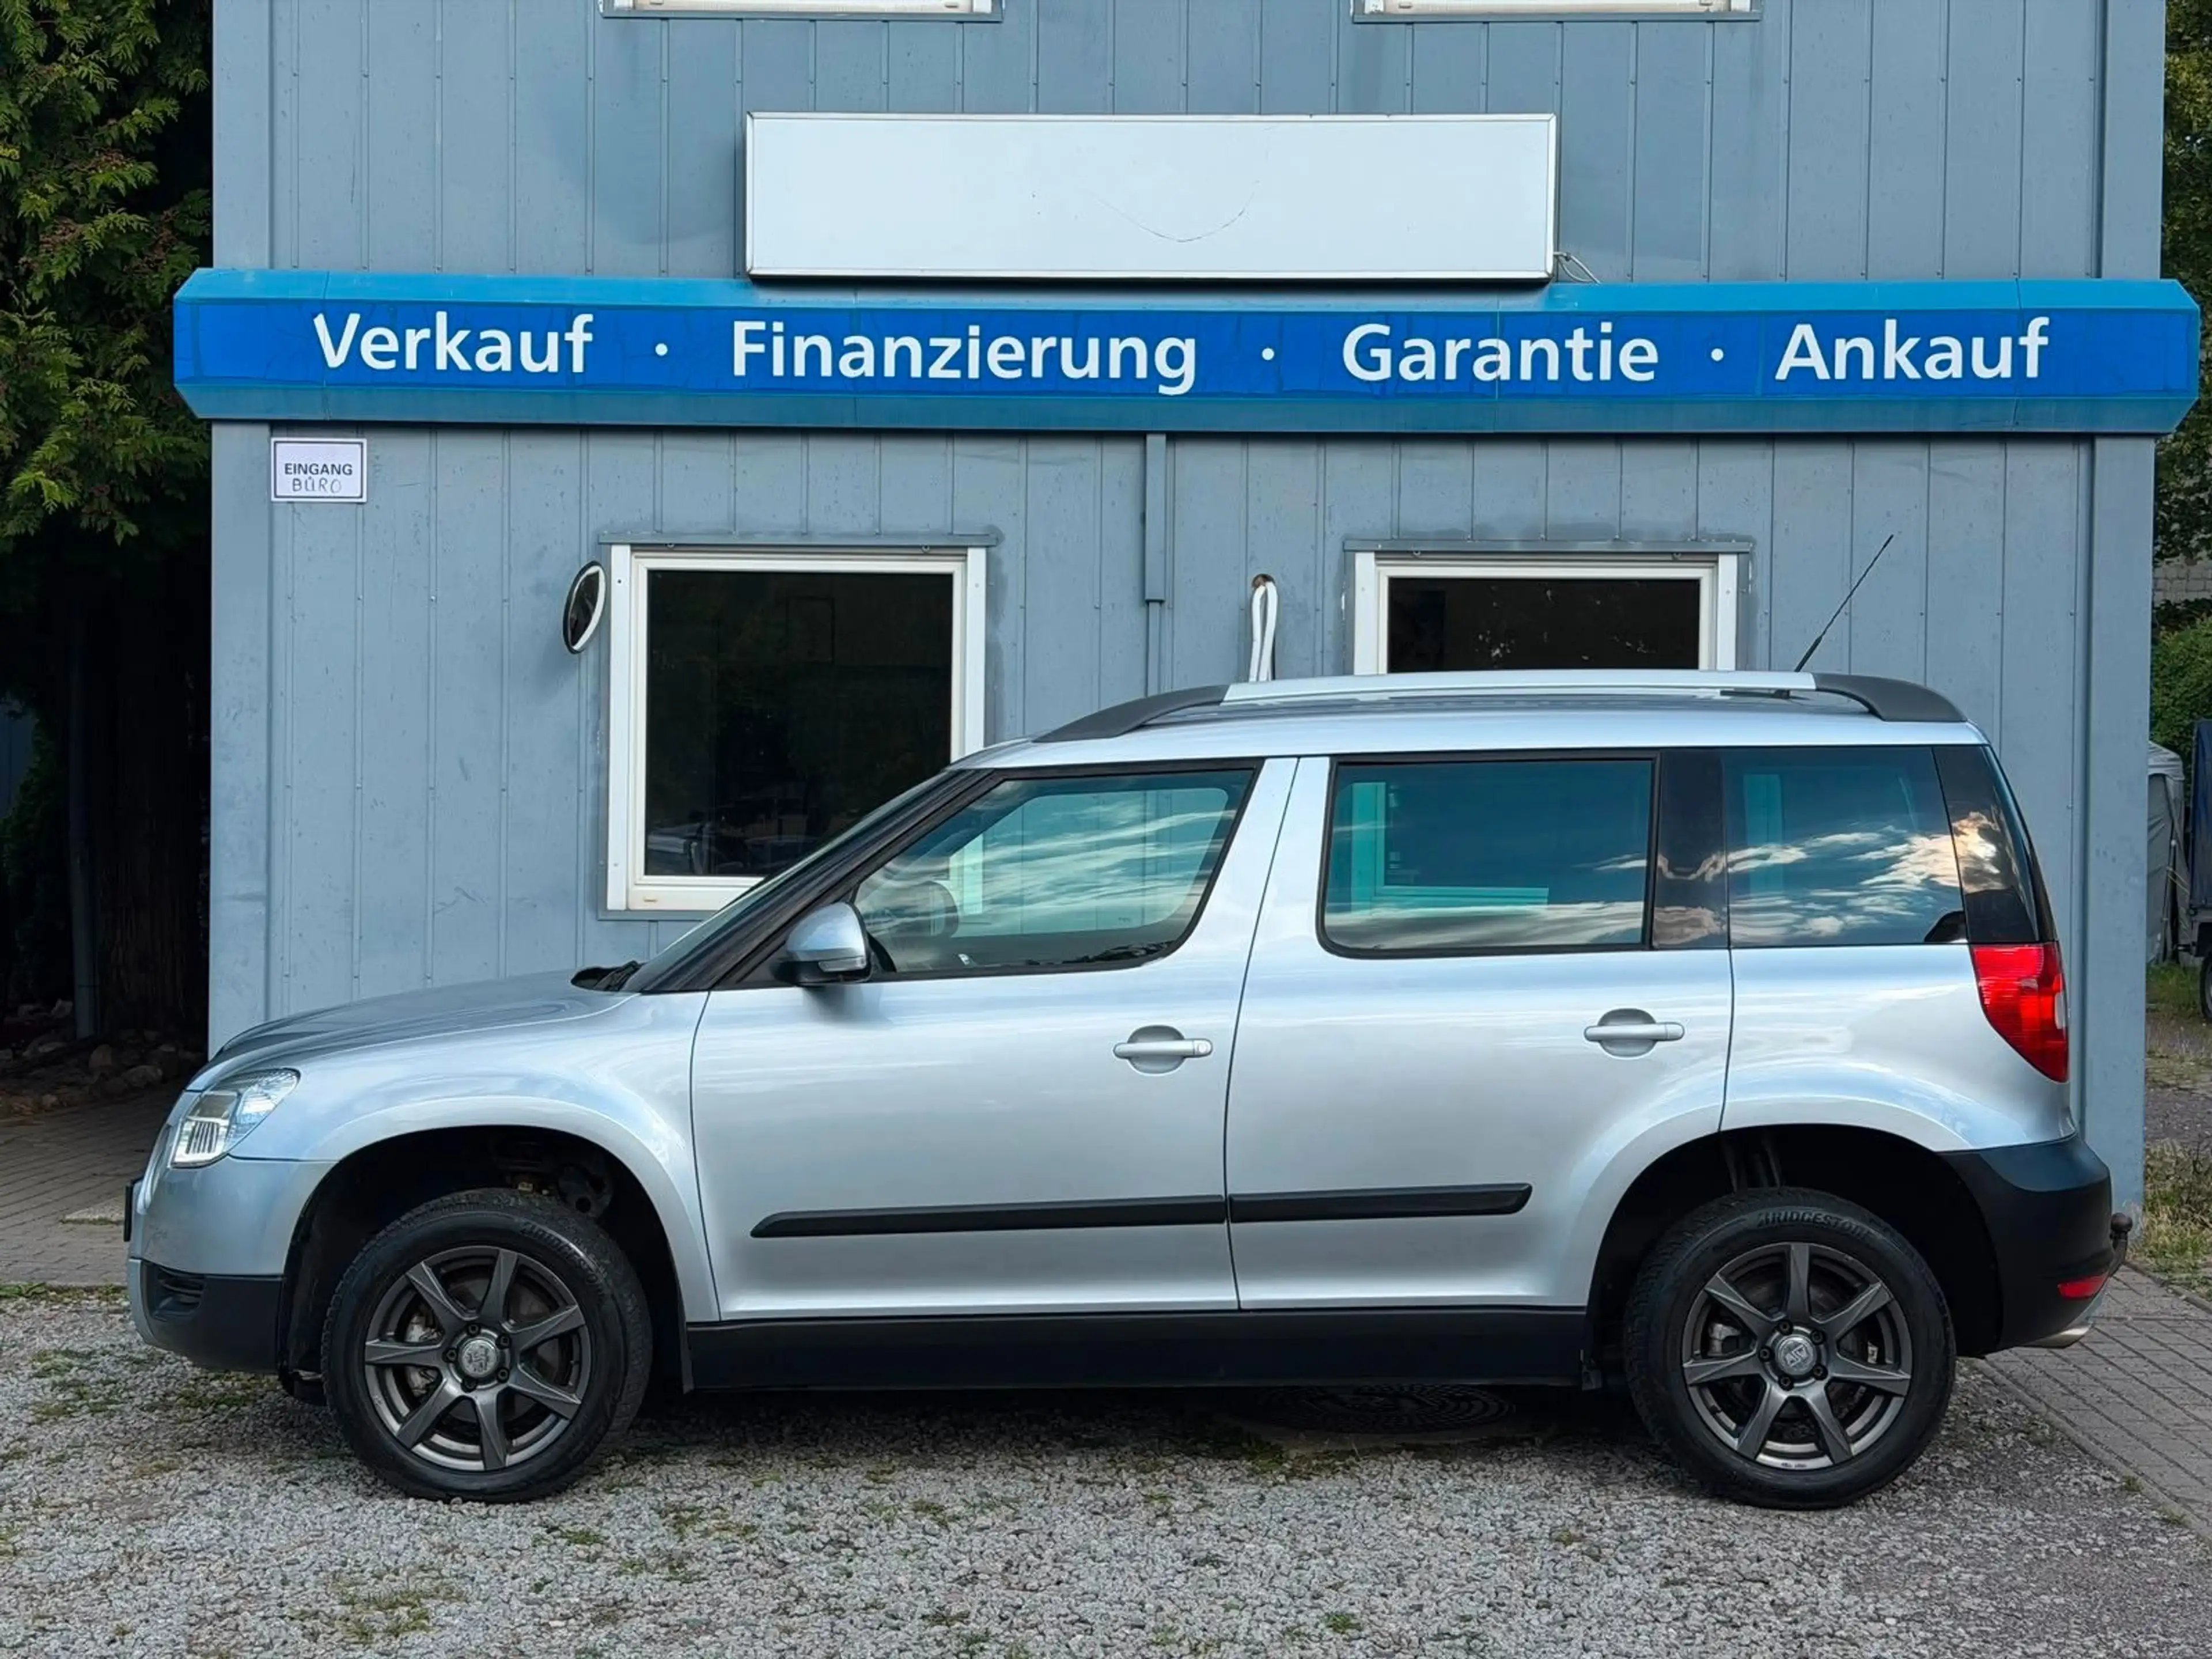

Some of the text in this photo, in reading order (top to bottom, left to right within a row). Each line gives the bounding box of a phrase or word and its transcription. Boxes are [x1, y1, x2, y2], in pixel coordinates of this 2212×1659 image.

[314, 311, 2050, 396] Verkauf Finanzierung Garantie Ankauf
[285, 463, 353, 475] EINGANG
[292, 476, 343, 493] BÜRO
